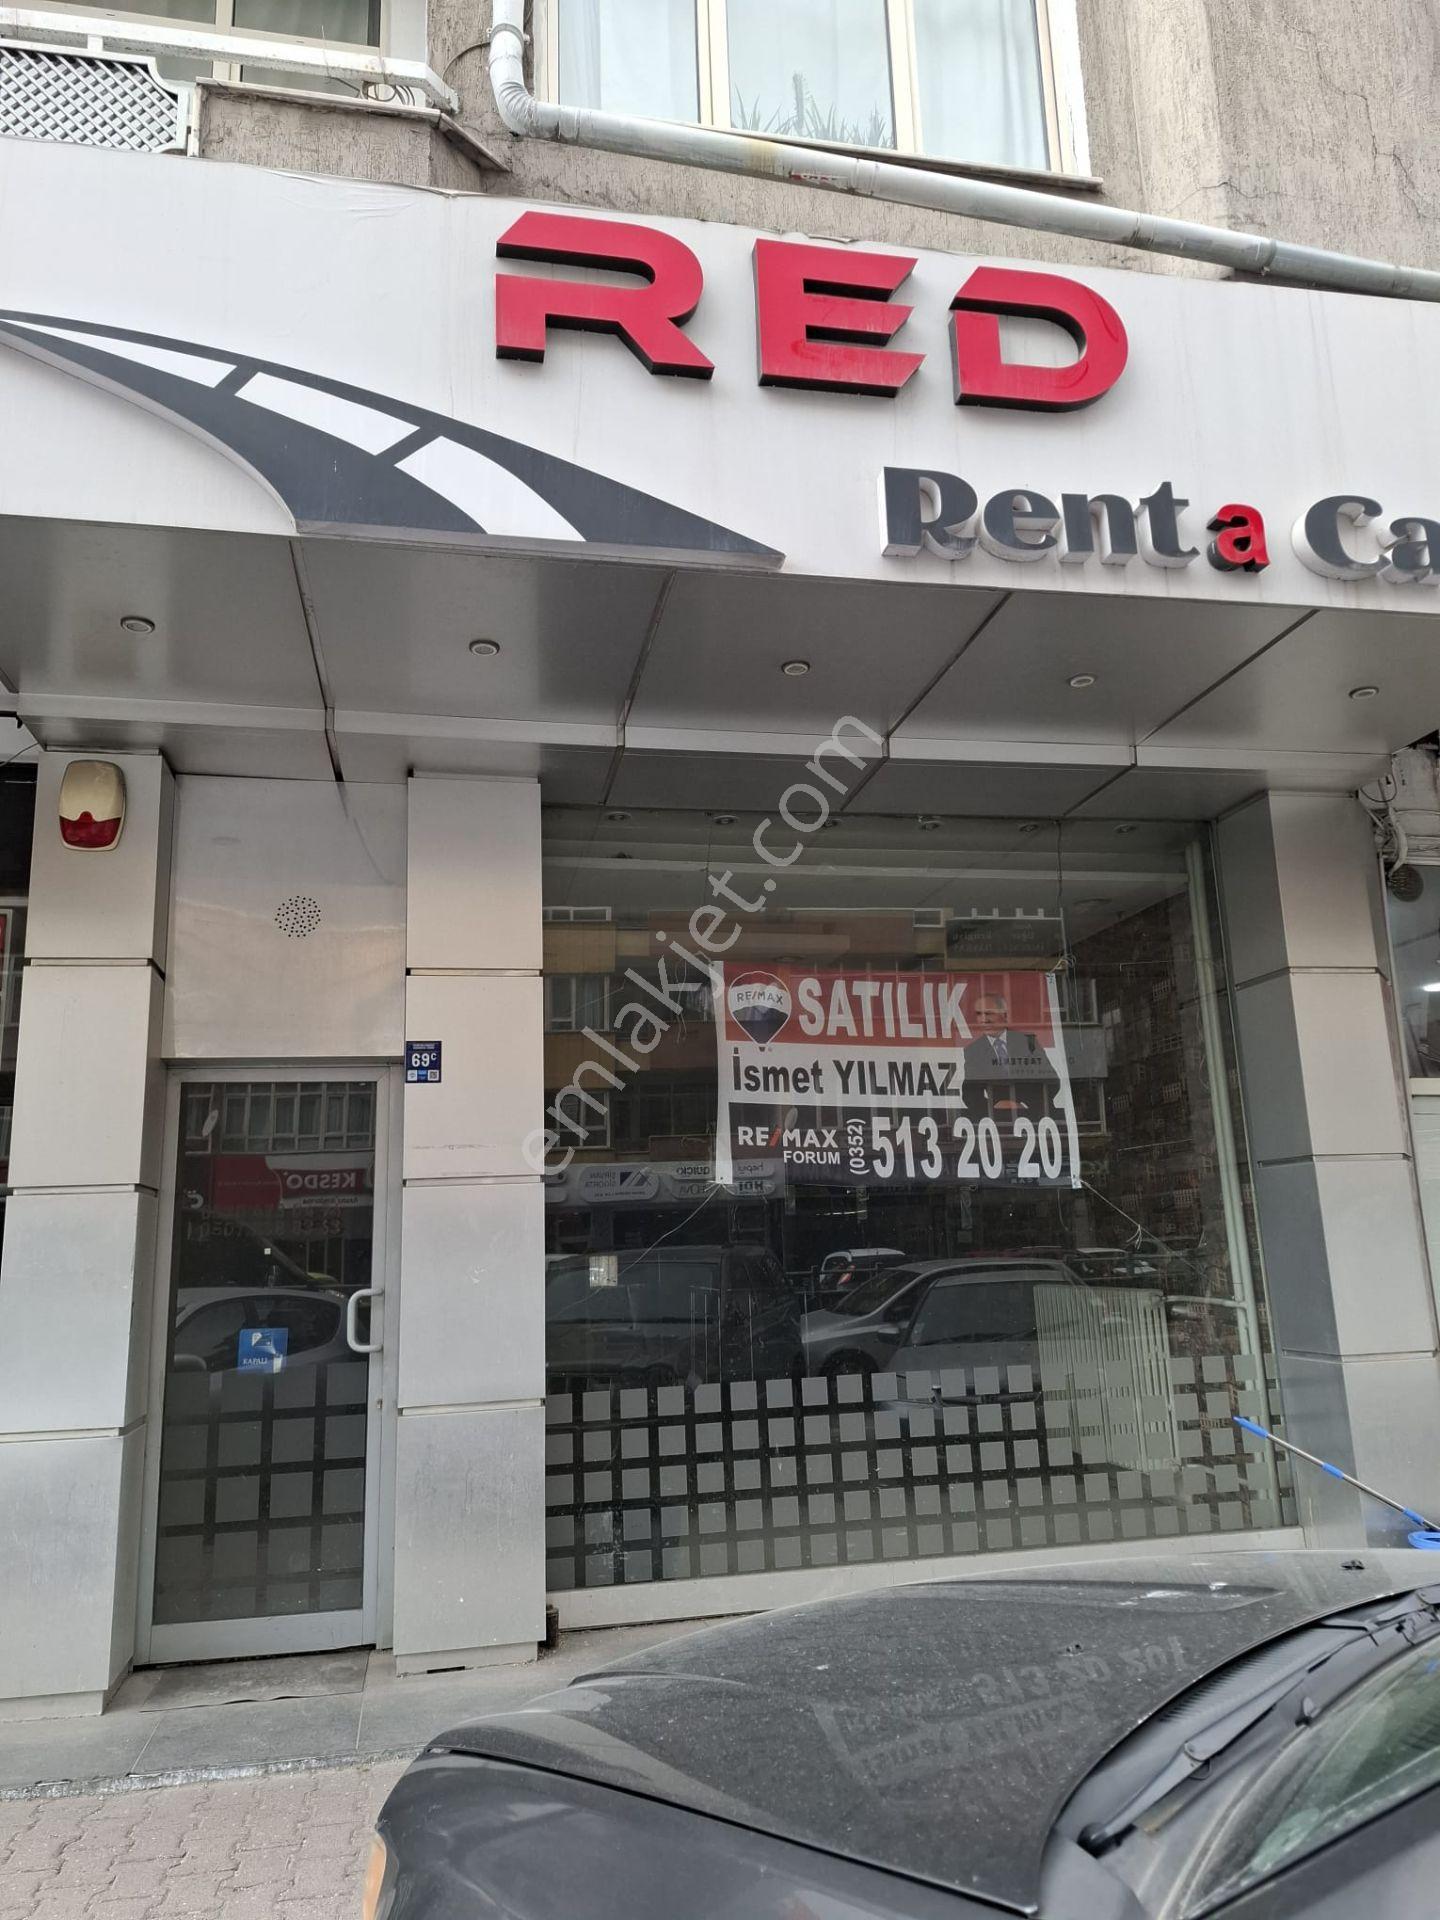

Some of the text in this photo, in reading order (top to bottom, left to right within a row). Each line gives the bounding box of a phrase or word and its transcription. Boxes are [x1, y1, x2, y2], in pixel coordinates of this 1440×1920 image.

[496, 210, 1129, 413] RED
[877, 466, 1200, 569] Rent
[1207, 504, 1270, 573] a
[736, 990, 783, 1005] RE/MAX
[798, 977, 972, 1039] SATILIK
[732, 1047, 960, 1096] İsmet YILMAZ
[738, 1125, 838, 1148] RE/MAX
[783, 1151, 840, 1165] FORUM
[846, 1118, 870, 1175] (0352)
[871, 1116, 1062, 1179] 513 20 20
